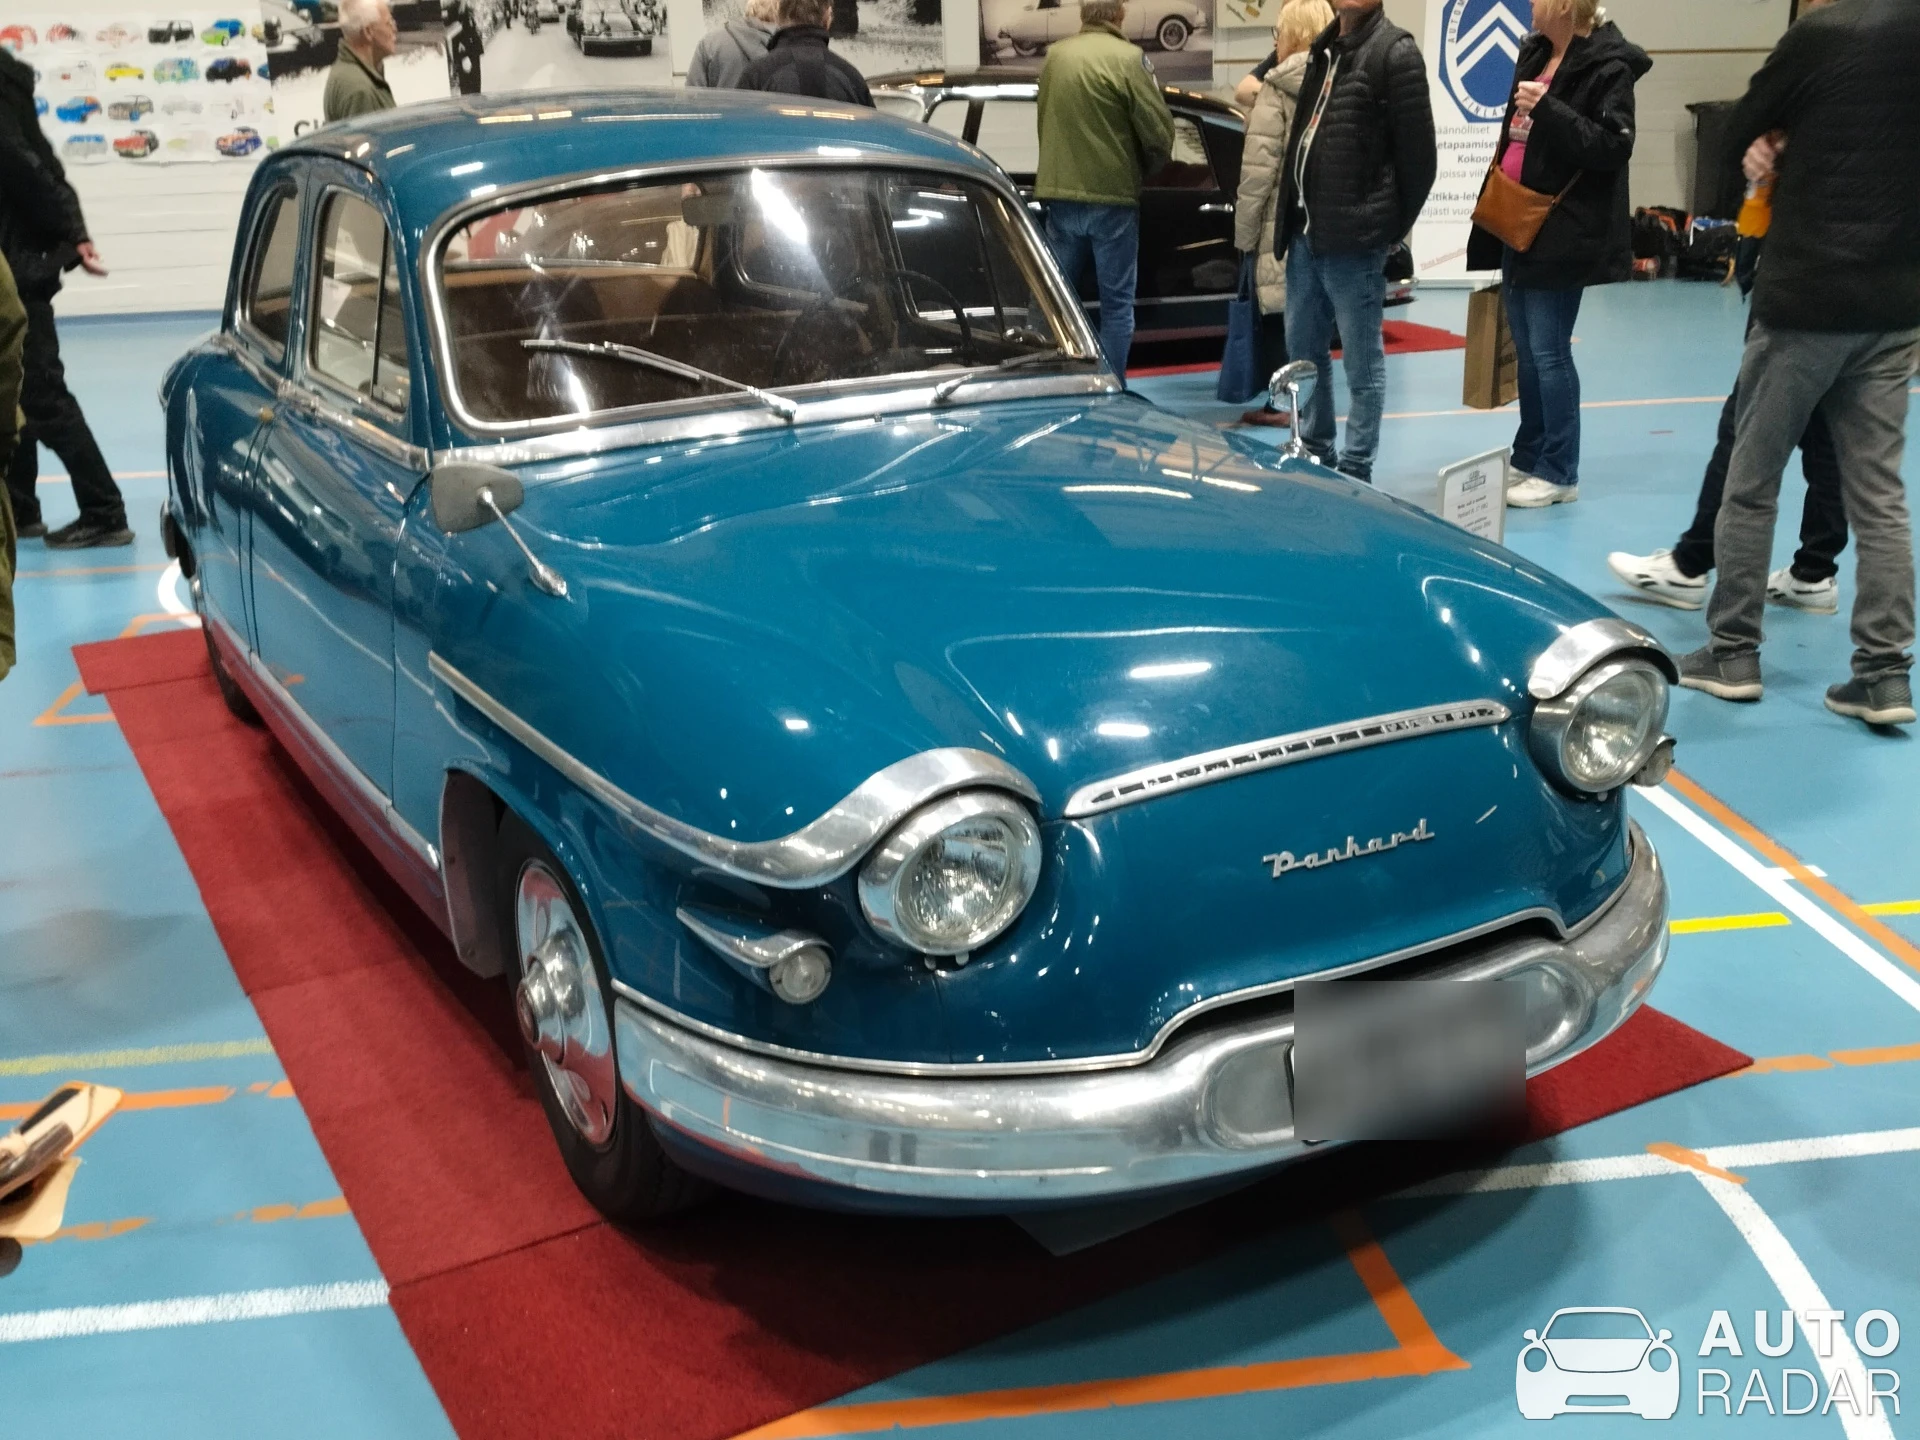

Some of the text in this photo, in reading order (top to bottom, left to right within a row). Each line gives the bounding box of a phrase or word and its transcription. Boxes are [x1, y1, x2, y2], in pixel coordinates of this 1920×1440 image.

[1436, 125, 1490, 135] äännölliset
[1436, 140, 1498, 151] etapaamiset
[1439, 169, 1467, 180] joissa
[1420, 206, 1450, 217] eljästi
[1262, 819, 1435, 878] Panhard
